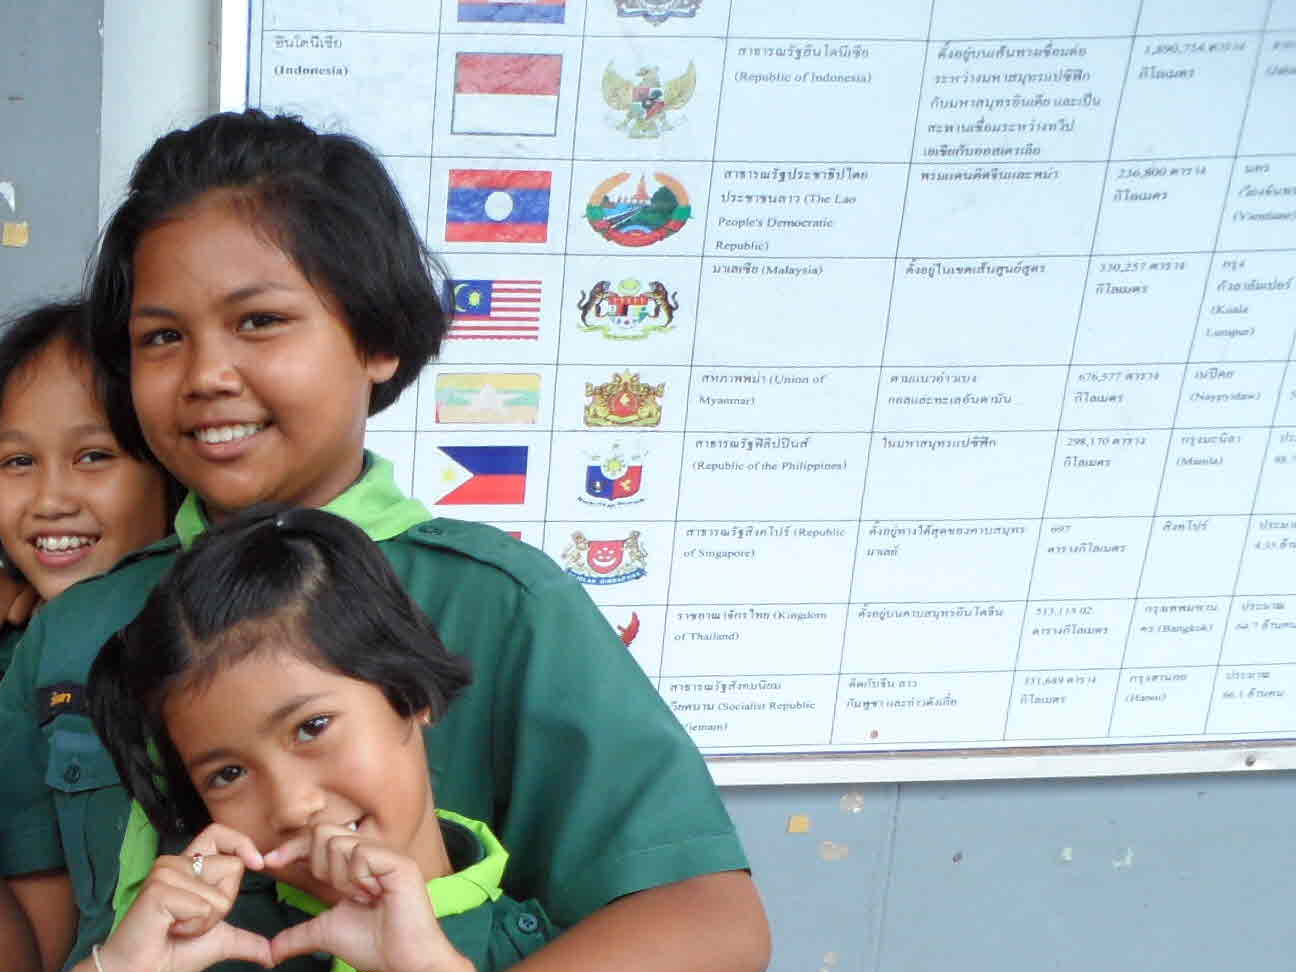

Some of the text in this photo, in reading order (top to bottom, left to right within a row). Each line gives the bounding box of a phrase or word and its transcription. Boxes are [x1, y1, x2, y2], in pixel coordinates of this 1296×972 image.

[274, 65, 349, 77] (Indonesia)
[734, 71, 872, 84] (Republic of Indonesia)
[804, 193, 831, 205] (The
[835, 194, 857, 204] Lao
[718, 217, 833, 230] People's Democratic
[715, 241, 769, 252] Republic)
[761, 264, 823, 277] (Malaysia)
[769, 375, 809, 385] (Union
[812, 374, 826, 384] of
[699, 396, 755, 406] Myanmar)
[692, 460, 747, 472] (Republic
[761, 461, 778, 470] the
[781, 460, 847, 472] Philippines)
[793, 528, 846, 538] (Republic
[683, 549, 755, 560] of Singapore)
[773, 610, 827, 621] (Kingdom
[674, 632, 740, 641] of Thailand)
[717, 702, 766, 711] (Socialist
[769, 702, 815, 711] Republic
